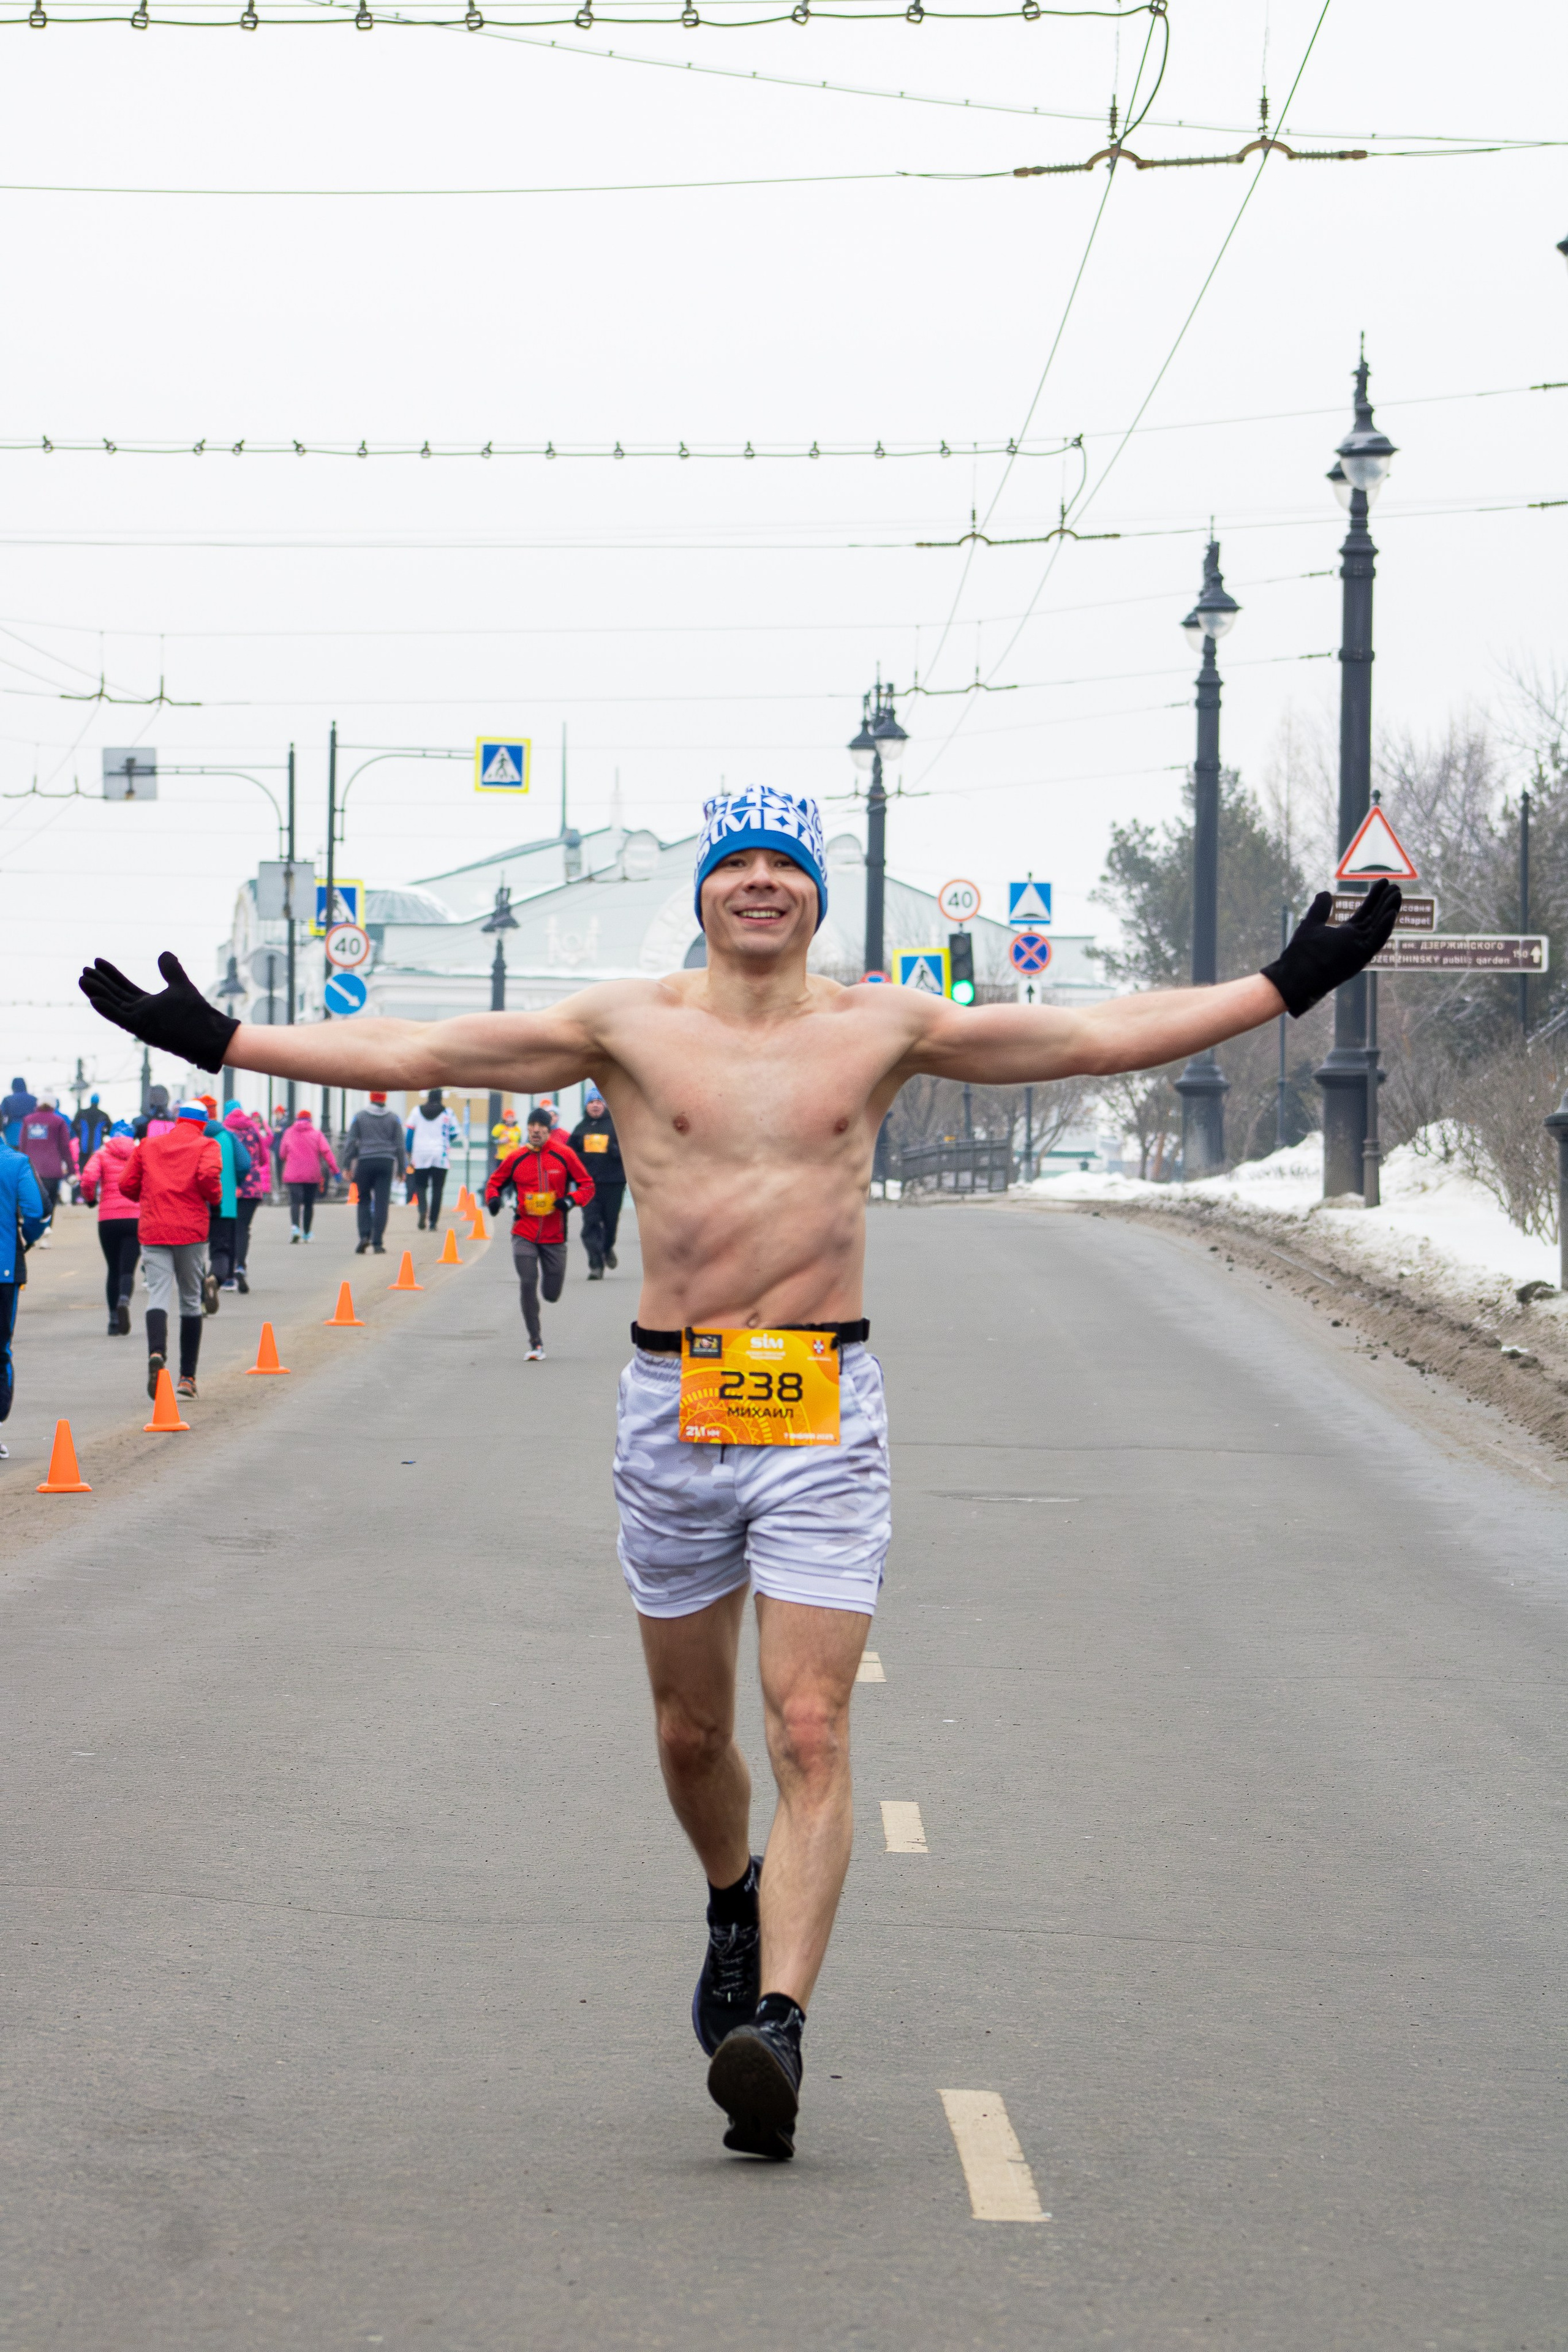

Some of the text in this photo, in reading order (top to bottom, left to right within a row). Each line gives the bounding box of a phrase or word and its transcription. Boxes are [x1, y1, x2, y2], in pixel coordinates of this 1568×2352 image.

[948, 891, 973, 908] 40
[334, 938, 361, 956] 40
[1420, 940, 1504, 951] ДЗЕРЖИНСКОГО
[1442, 955, 1472, 965] public
[719, 1371, 803, 1402] 238
[726, 1407, 794, 1419] МИХАИЛ
